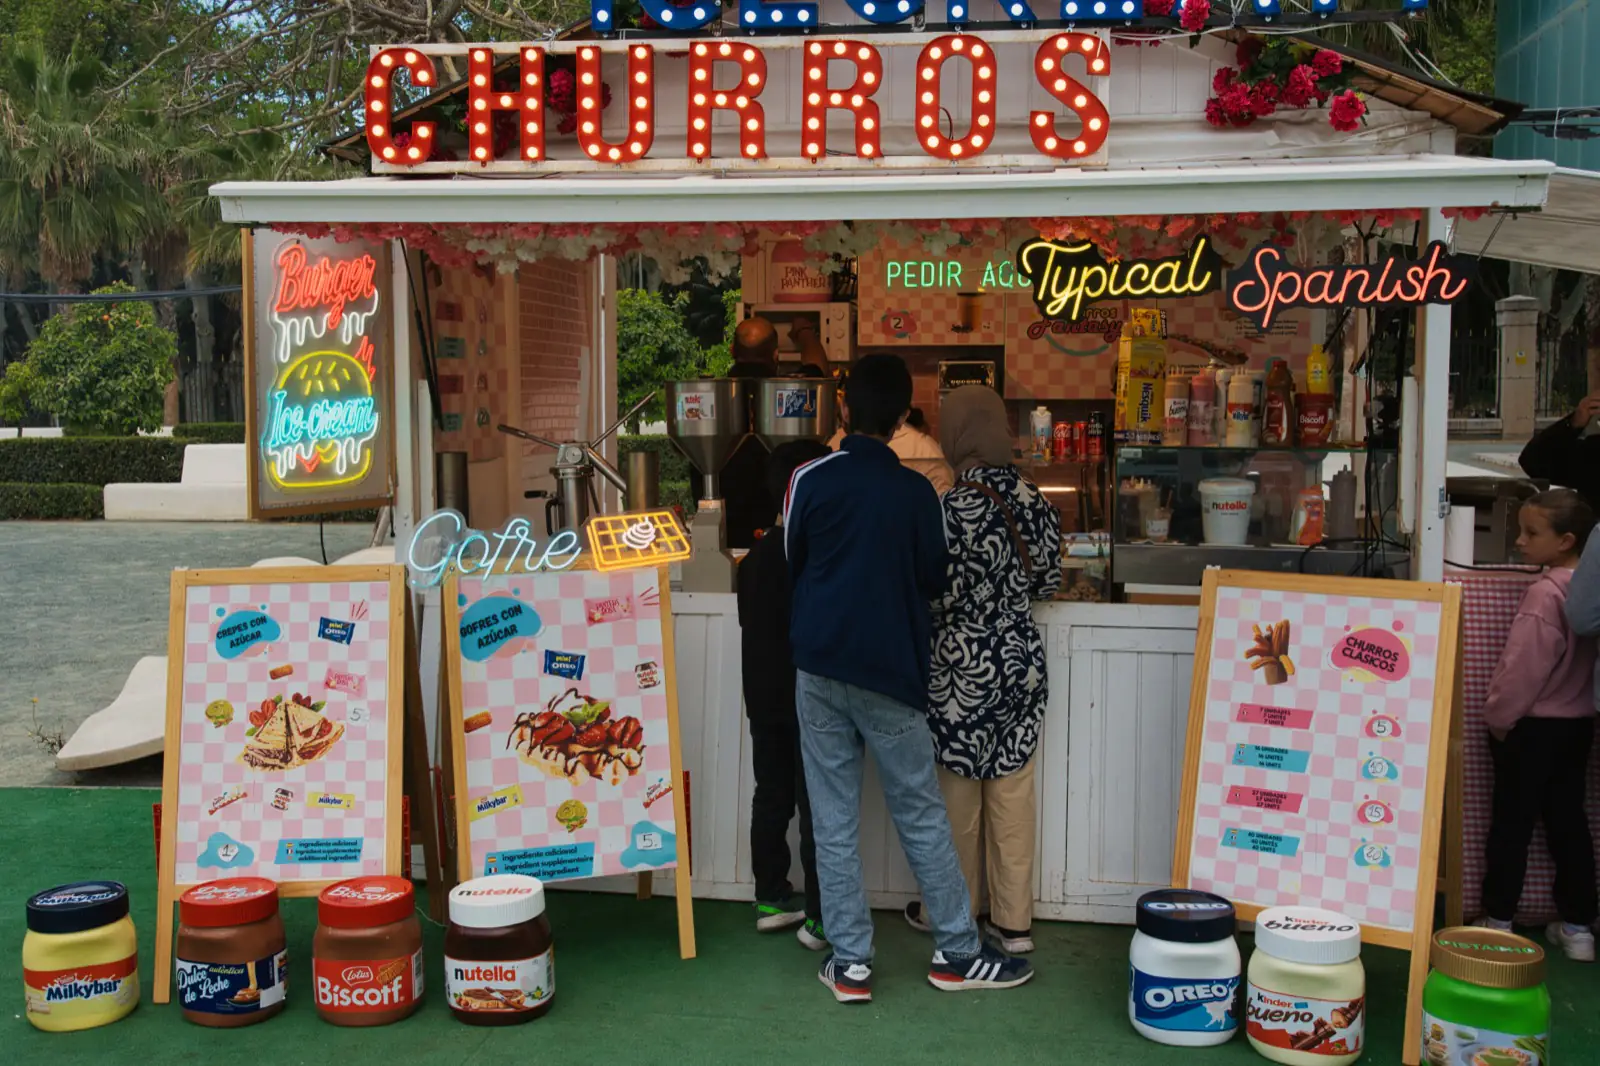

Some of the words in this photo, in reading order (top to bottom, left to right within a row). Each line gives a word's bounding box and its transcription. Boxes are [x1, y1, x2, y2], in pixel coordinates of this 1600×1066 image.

[364, 33, 1110, 164] CHURROS
[887, 261, 962, 287] PEDIR
[982, 259, 1031, 288] AQU
[1022, 238, 1211, 320] Typical
[275, 244, 376, 330] Burger
[1232, 245, 1467, 328] Spanish
[1212, 501, 1247, 510] nutella
[409, 511, 582, 588] Gofre
[500, 604, 522, 622] CON
[216, 621, 249, 640] CREPES
[249, 615, 267, 629] CON
[477, 624, 518, 650] AZÚCAR
[230, 630, 262, 649] AZÚCAR
[1346, 636, 1399, 663] CHURROS
[1376, 720, 1386, 734] 5
[318, 797, 343, 805] Milkybar
[477, 795, 507, 812] Milkybar
[299, 840, 332, 849] ingrediente
[502, 851, 544, 863] ingrediente
[544, 845, 578, 857] adicional
[541, 866, 579, 877] ingredient
[328, 886, 405, 901] Biscoff
[458, 888, 532, 896] nutella
[1147, 902, 1229, 911] OREO
[1264, 920, 1354, 931] bueno
[178, 968, 208, 991] Dulce
[347, 968, 371, 981] Lotus
[454, 966, 518, 982] nutella
[46, 978, 122, 1001] Milkybar
[184, 987, 197, 1003] de
[199, 976, 229, 999] Leche
[317, 976, 404, 1006] Biscoff
[1144, 984, 1228, 1008] OREO
[1247, 997, 1314, 1023] bueno
